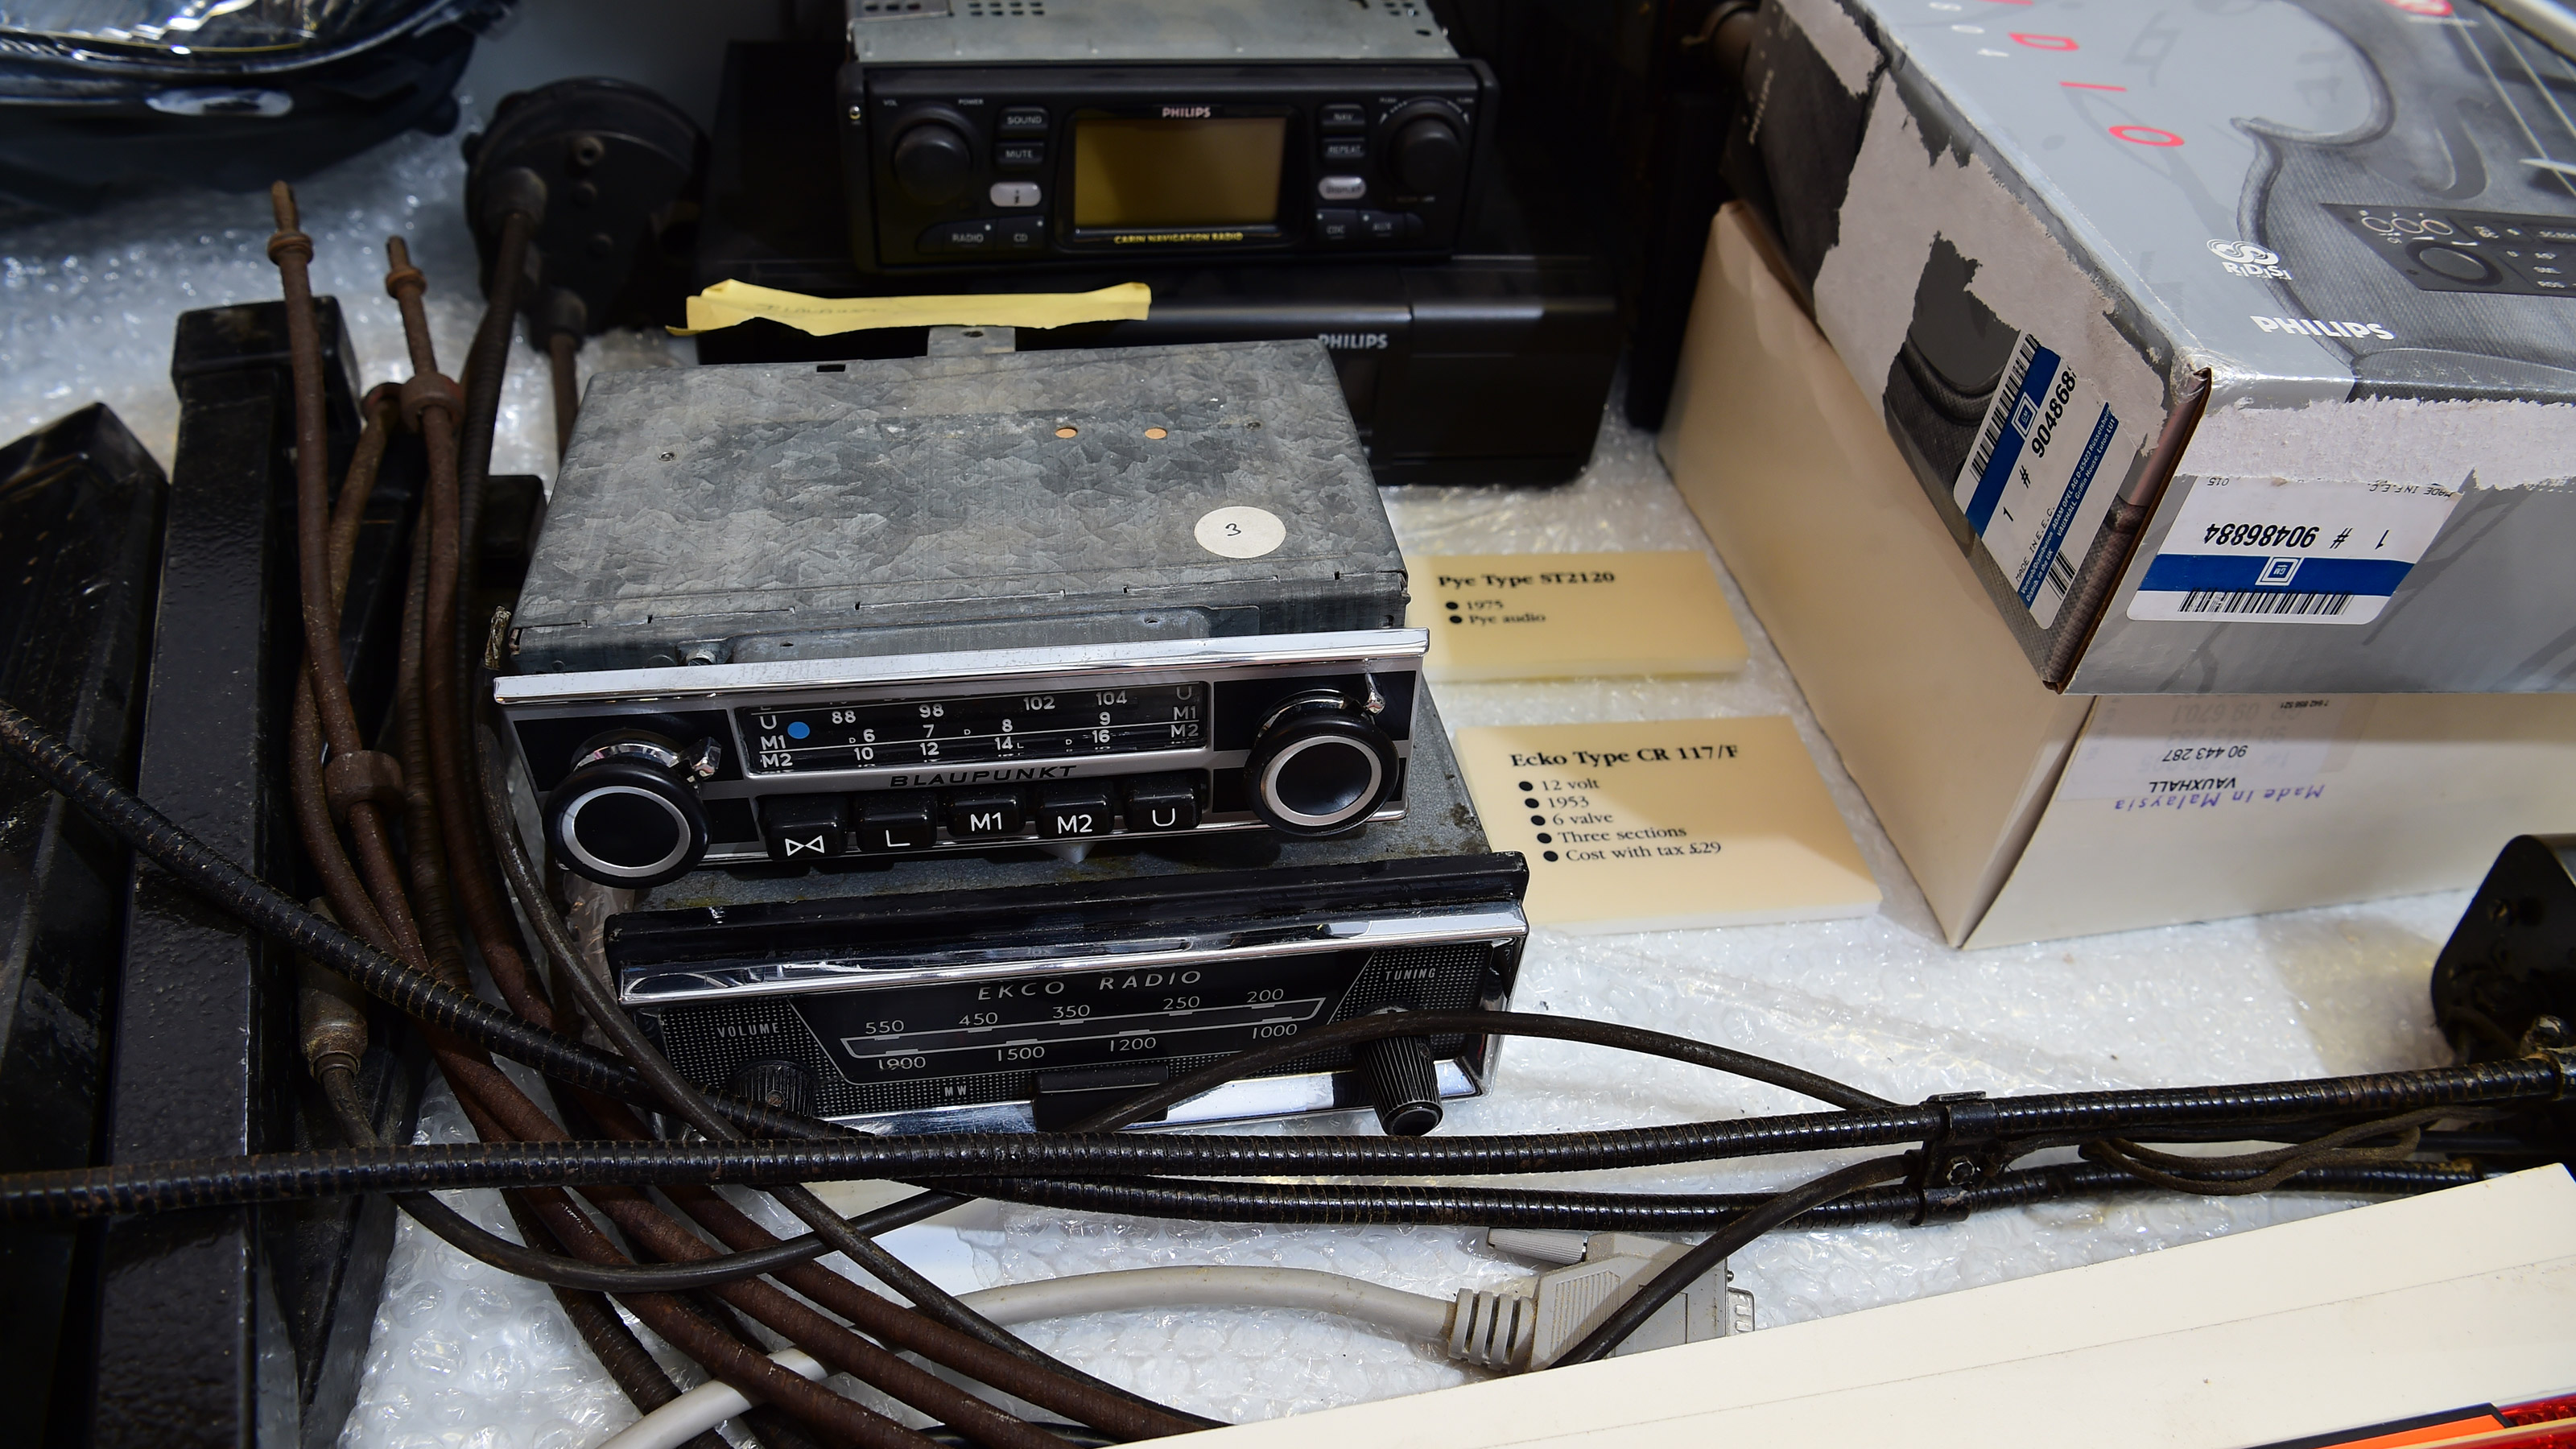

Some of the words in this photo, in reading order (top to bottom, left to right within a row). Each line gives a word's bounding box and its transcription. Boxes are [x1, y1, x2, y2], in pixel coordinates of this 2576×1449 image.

[1007, 116, 1042, 125] SOUND
[1162, 107, 1211, 118] PHILIPS
[1005, 150, 1032, 159] MUTE
[952, 233, 984, 242] RADIO
[1013, 233, 1028, 242] CD
[1147, 233, 1210, 242] NAVIGATION
[2250, 315, 2395, 341] PHILIPS
[1318, 332, 1388, 349] PHILIPS
[2032, 365, 2077, 458] 904868
[2074, 477, 2087, 499] Griffin
[2096, 433, 2108, 453] Luton
[2051, 506, 2064, 530] ADAM
[2062, 489, 2073, 507] OPEL
[2070, 477, 2078, 489] AG
[2075, 450, 2091, 478] D-65423
[1225, 523, 1241, 536] 3
[2203, 523, 2319, 548] 90486884
[2329, 527, 2352, 549] #
[2375, 529, 2389, 550] 1
[2040, 559, 2048, 571] the
[2046, 548, 2053, 559] UK
[2015, 556, 2029, 581] MADE
[1438, 575, 1476, 589] Pye
[1481, 573, 1533, 588] Type
[1540, 572, 1615, 584] ST2120
[1467, 600, 1504, 610] 1975
[1469, 614, 1496, 625] Pye
[1503, 613, 1546, 623] audio
[759, 714, 778, 730] U
[832, 709, 857, 724] 88
[919, 703, 944, 718] 98
[1023, 696, 1055, 711] 102
[1096, 690, 1128, 706] 104
[1176, 685, 1192, 700] U
[760, 734, 786, 750] M1
[863, 729, 875, 743] 6
[923, 724, 935, 738] 7
[1001, 718, 1013, 733] 8
[1099, 711, 1111, 726] 9
[1173, 706, 1197, 720] M1
[761, 753, 793, 769] M2
[853, 746, 874, 761] 10
[919, 741, 939, 756] 12
[994, 736, 1013, 750] 14
[1092, 729, 1111, 743] 16
[1170, 724, 1199, 738] M2
[2162, 748, 2193, 762] 287
[2195, 746, 2225, 760] 443
[2228, 745, 2248, 758] 90
[1509, 752, 1567, 766] Ecko
[1572, 750, 1631, 767] Type
[1637, 748, 1670, 762] CR
[1676, 745, 1739, 760] 117/F
[890, 765, 1077, 788] BLAUPUNKT
[1542, 780, 1562, 791] 12
[1567, 778, 1600, 790] volt
[2149, 777, 2236, 793] VAUXHALL
[2115, 792, 2221, 811] Malaysia
[2264, 784, 2326, 802] Made
[1548, 796, 1589, 809] 1953
[1552, 814, 1563, 825] 6
[1571, 812, 1614, 825] valve
[886, 829, 911, 848] L
[971, 811, 1002, 832] M1
[1057, 814, 1092, 835] M2
[1151, 807, 1176, 828] U
[1558, 831, 1610, 844] Three
[1616, 827, 1687, 840] sections
[1566, 849, 1606, 861] Cost
[1612, 845, 1652, 859] with
[1657, 845, 1684, 857] tax
[1689, 841, 1721, 855] £29
[1385, 968, 1436, 982] TUNING
[977, 980, 1065, 1001] EKCO
[1099, 971, 1202, 990] RADIO
[865, 1019, 905, 1035] 550
[958, 1012, 998, 1027] 450
[1052, 1005, 1091, 1019] 350
[1162, 996, 1200, 1010] 250
[1246, 989, 1284, 1003] 200
[716, 1022, 780, 1038] VOLUME
[997, 1046, 1046, 1062] 1500
[1109, 1037, 1157, 1052] 1200
[1252, 1023, 1298, 1039] 1000
